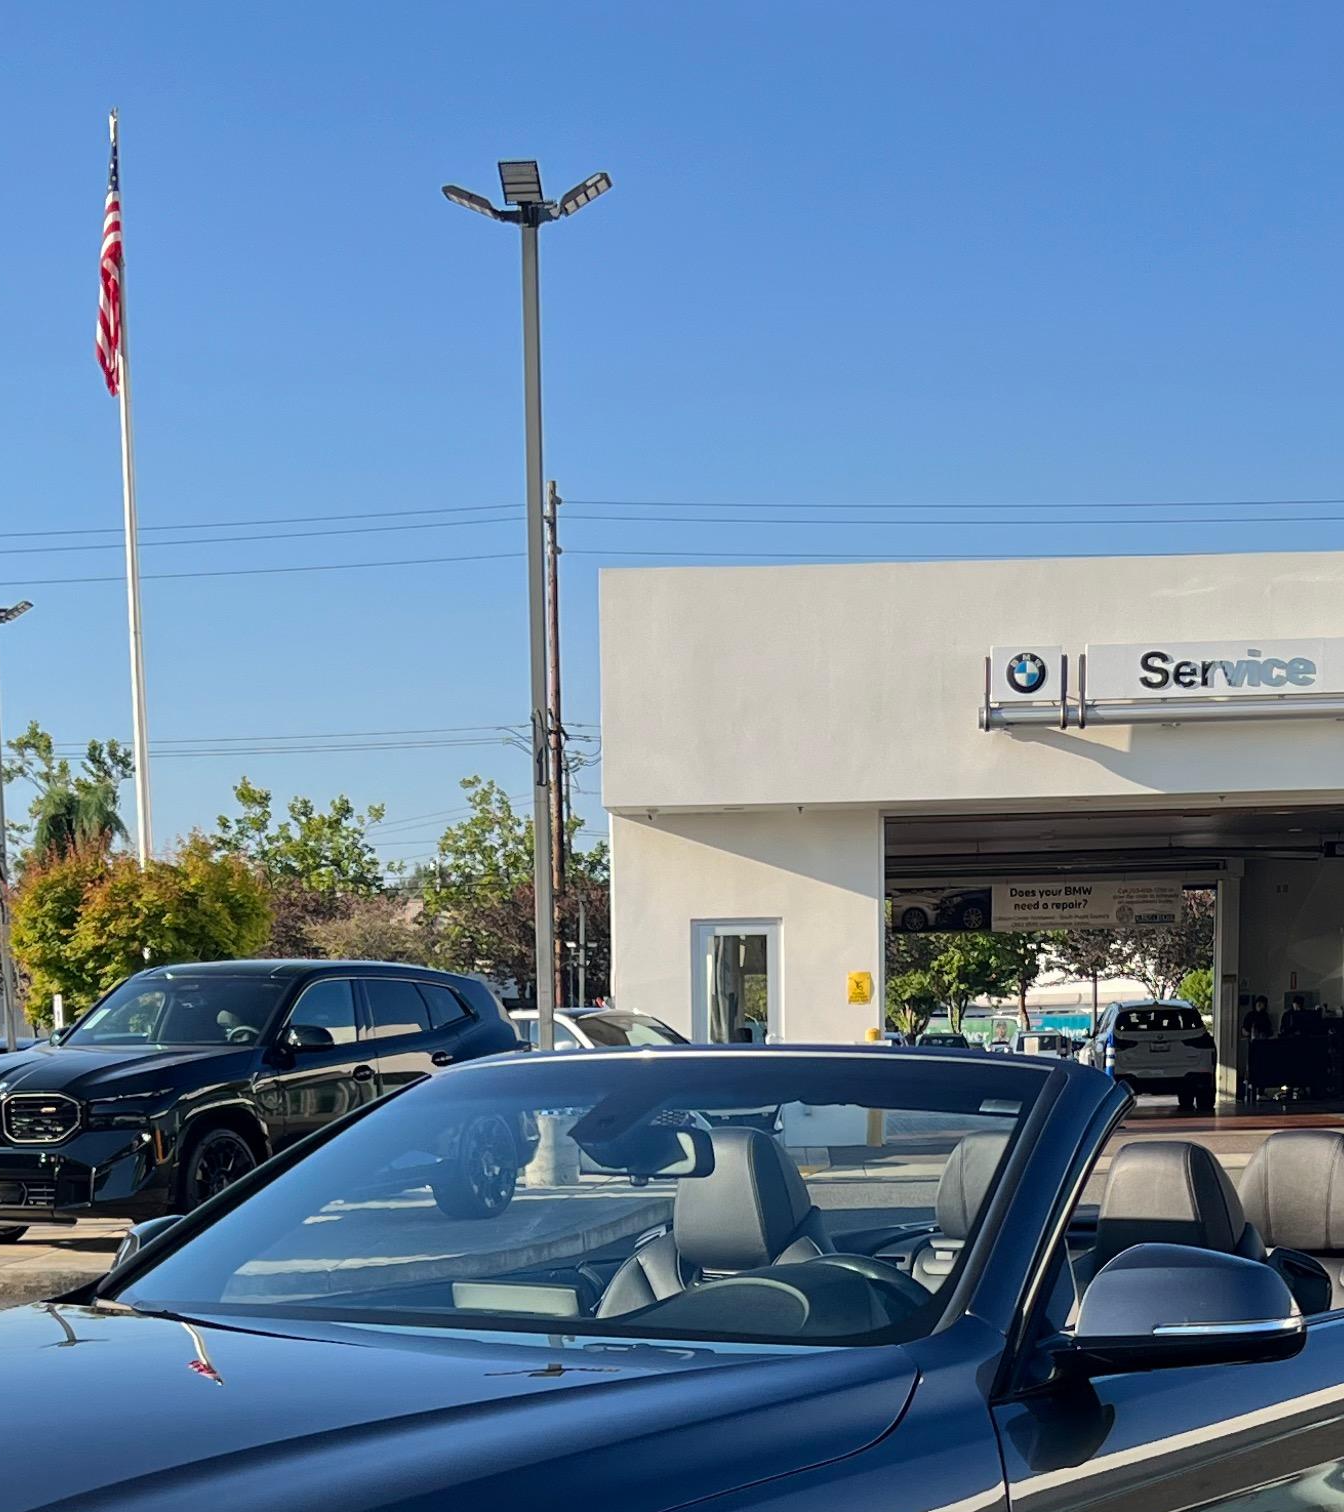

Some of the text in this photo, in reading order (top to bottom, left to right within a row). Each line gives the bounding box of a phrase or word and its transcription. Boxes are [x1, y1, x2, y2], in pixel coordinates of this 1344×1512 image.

[1139, 649, 1316, 690] Service
[1009, 886, 1093, 899] Does your BMW
[1013, 901, 1040, 911] need
[1050, 899, 1089, 911] repair?
